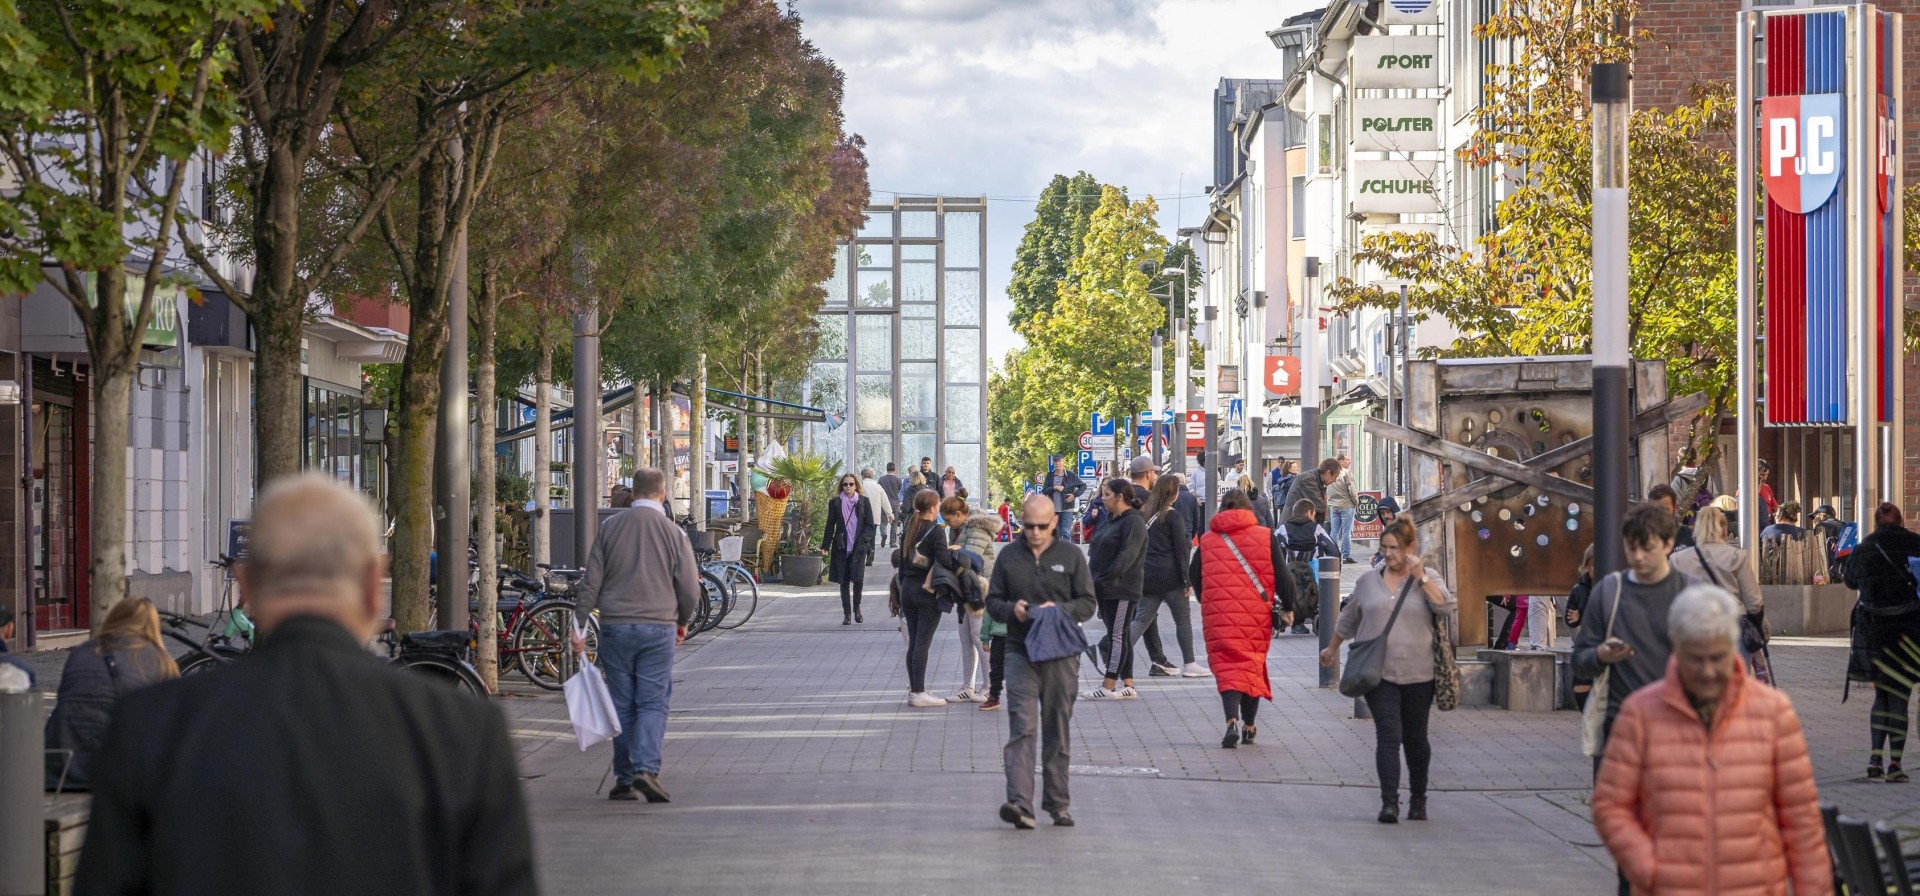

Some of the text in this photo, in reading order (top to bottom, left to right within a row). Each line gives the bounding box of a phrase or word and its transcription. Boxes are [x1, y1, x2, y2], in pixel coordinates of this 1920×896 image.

[1377, 55, 1432, 69] SPORT
[1362, 117, 1433, 132] POLSTER
[1360, 179, 1433, 194] SCHUHE
[1521, 364, 1555, 380] NOBEL
[1081, 452, 1090, 464] P
